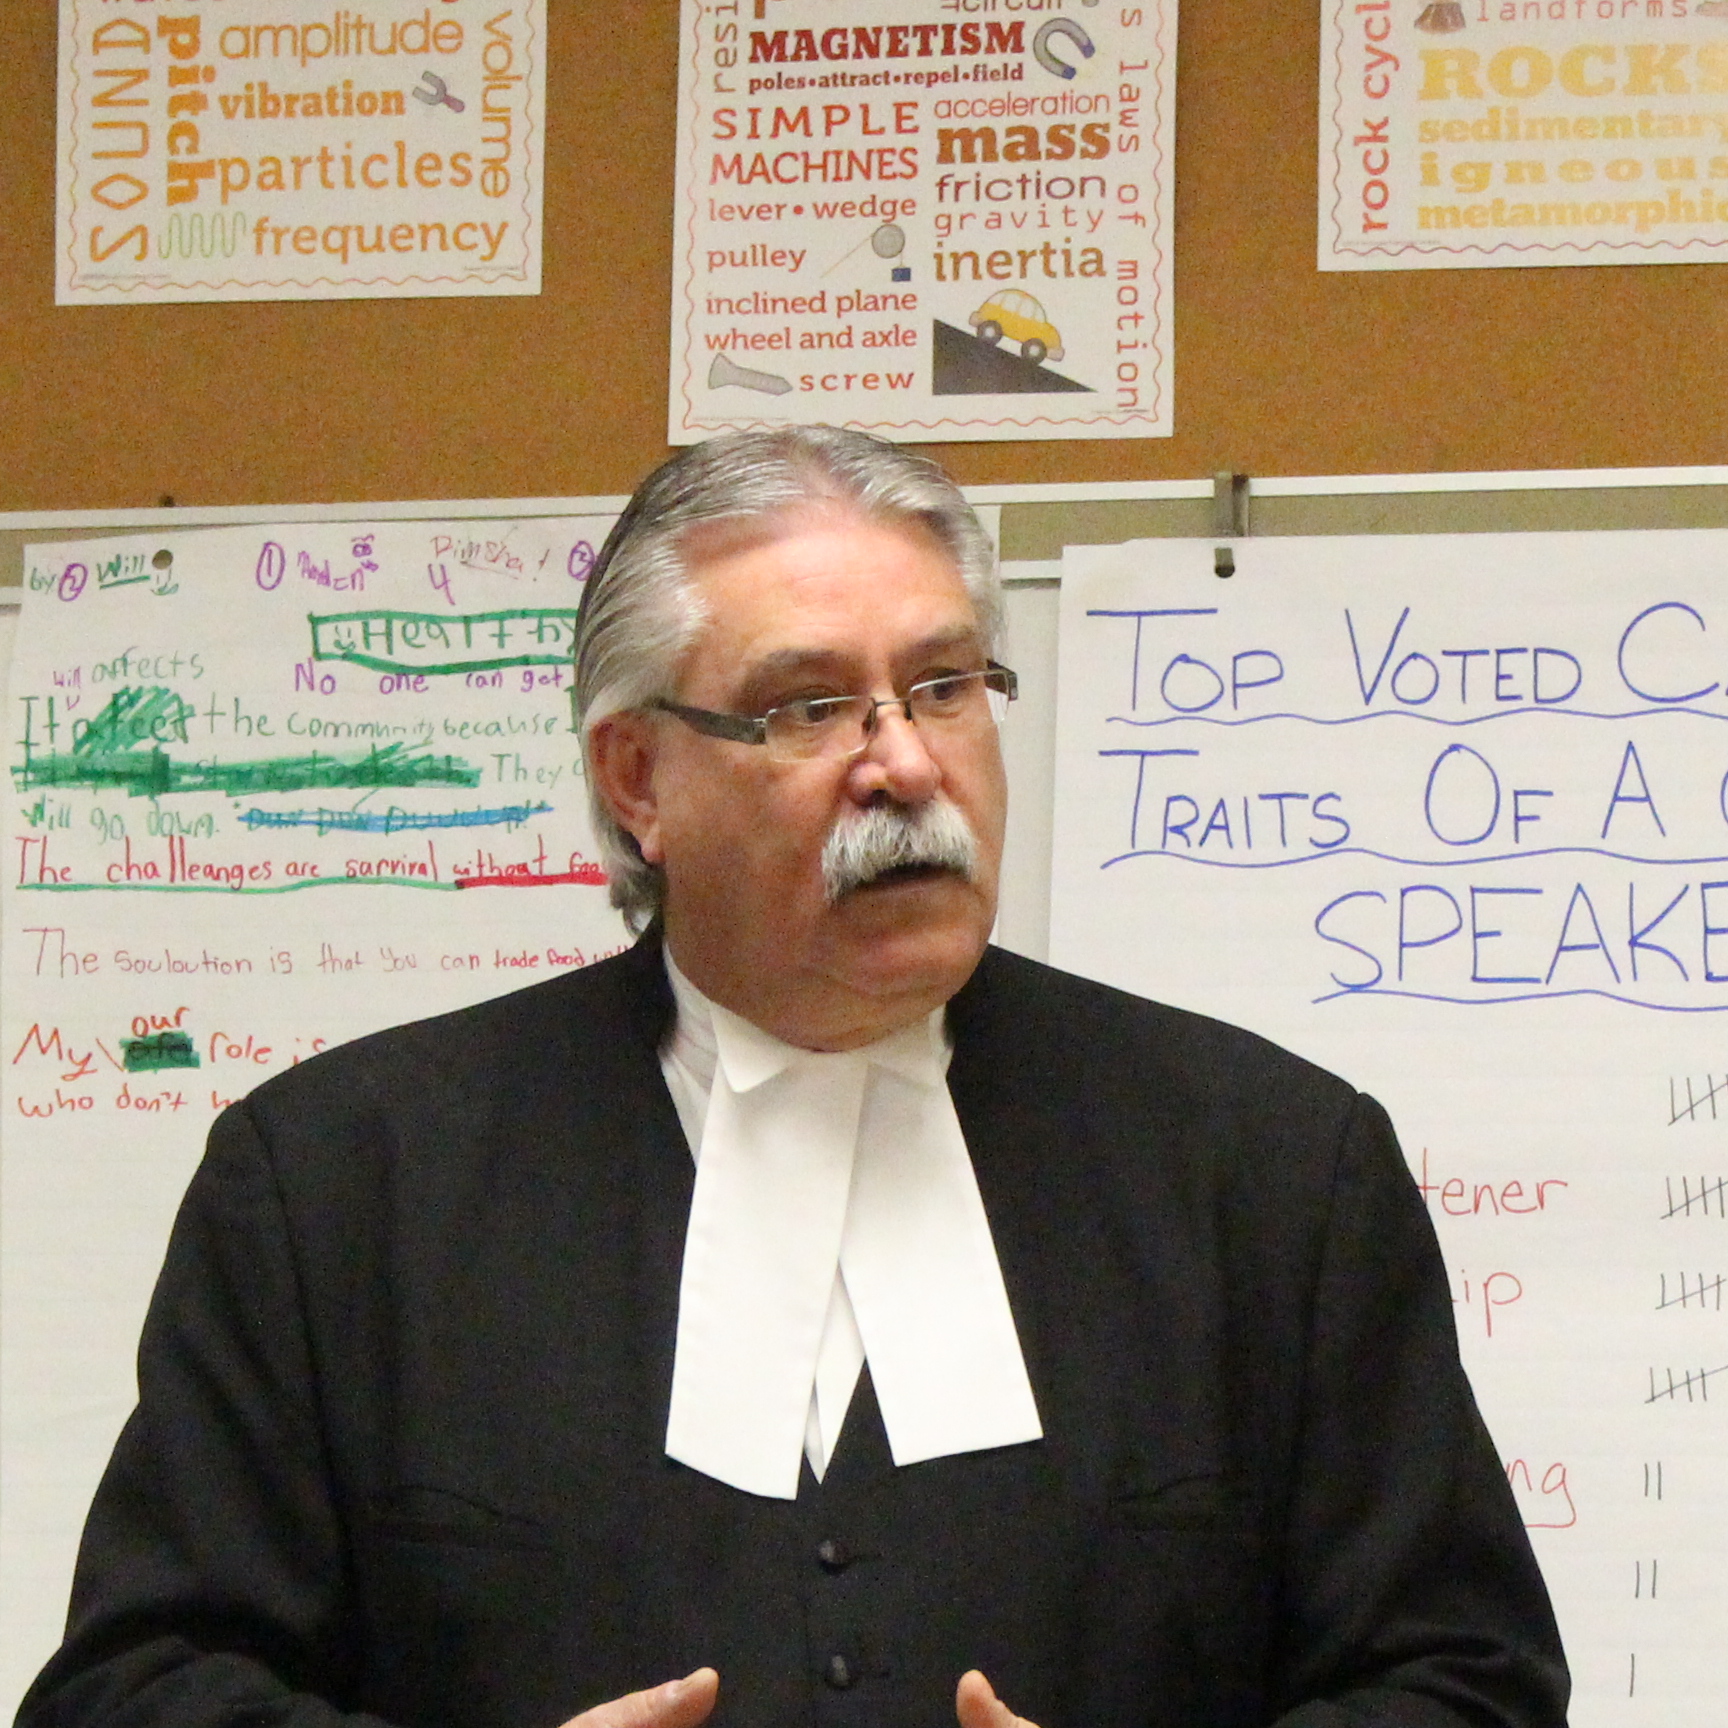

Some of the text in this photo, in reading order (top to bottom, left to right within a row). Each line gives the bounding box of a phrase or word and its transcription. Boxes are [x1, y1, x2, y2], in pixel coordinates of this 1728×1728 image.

[219, 10, 464, 67] amplitude
[748, 21, 1025, 64] MAGNETISM
[157, 15, 216, 207] pitch
[218, 79, 405, 120] vibration
[480, 10, 523, 198] volume
[712, 102, 921, 140] SIMPLE
[933, 91, 1110, 120] acceleration
[1117, 60, 1149, 153] laws
[90, 17, 151, 262] SOUND
[935, 121, 1112, 165] mass
[218, 141, 473, 204] particles
[709, 147, 920, 185] MACHINES
[934, 171, 1106, 203] friction
[1353, 115, 1390, 234] rock
[709, 195, 917, 223] lever wedge
[934, 203, 1105, 238] gravity
[1117, 183, 1146, 229] of
[252, 215, 509, 263] frequency
[707, 245, 807, 273] pulley
[933, 241, 1107, 282] inertia
[706, 289, 918, 320] inclined plane
[705, 325, 918, 351] wheel and axle
[1116, 259, 1148, 409] motion
[799, 372, 915, 392] screw
[294, 657, 337, 694] No
[379, 673, 429, 694] one
[1599, 739, 1669, 839] A
[16, 836, 73, 885] The
[22, 926, 100, 979] The
[131, 1006, 191, 1038] our
[12, 1023, 99, 1083] My
